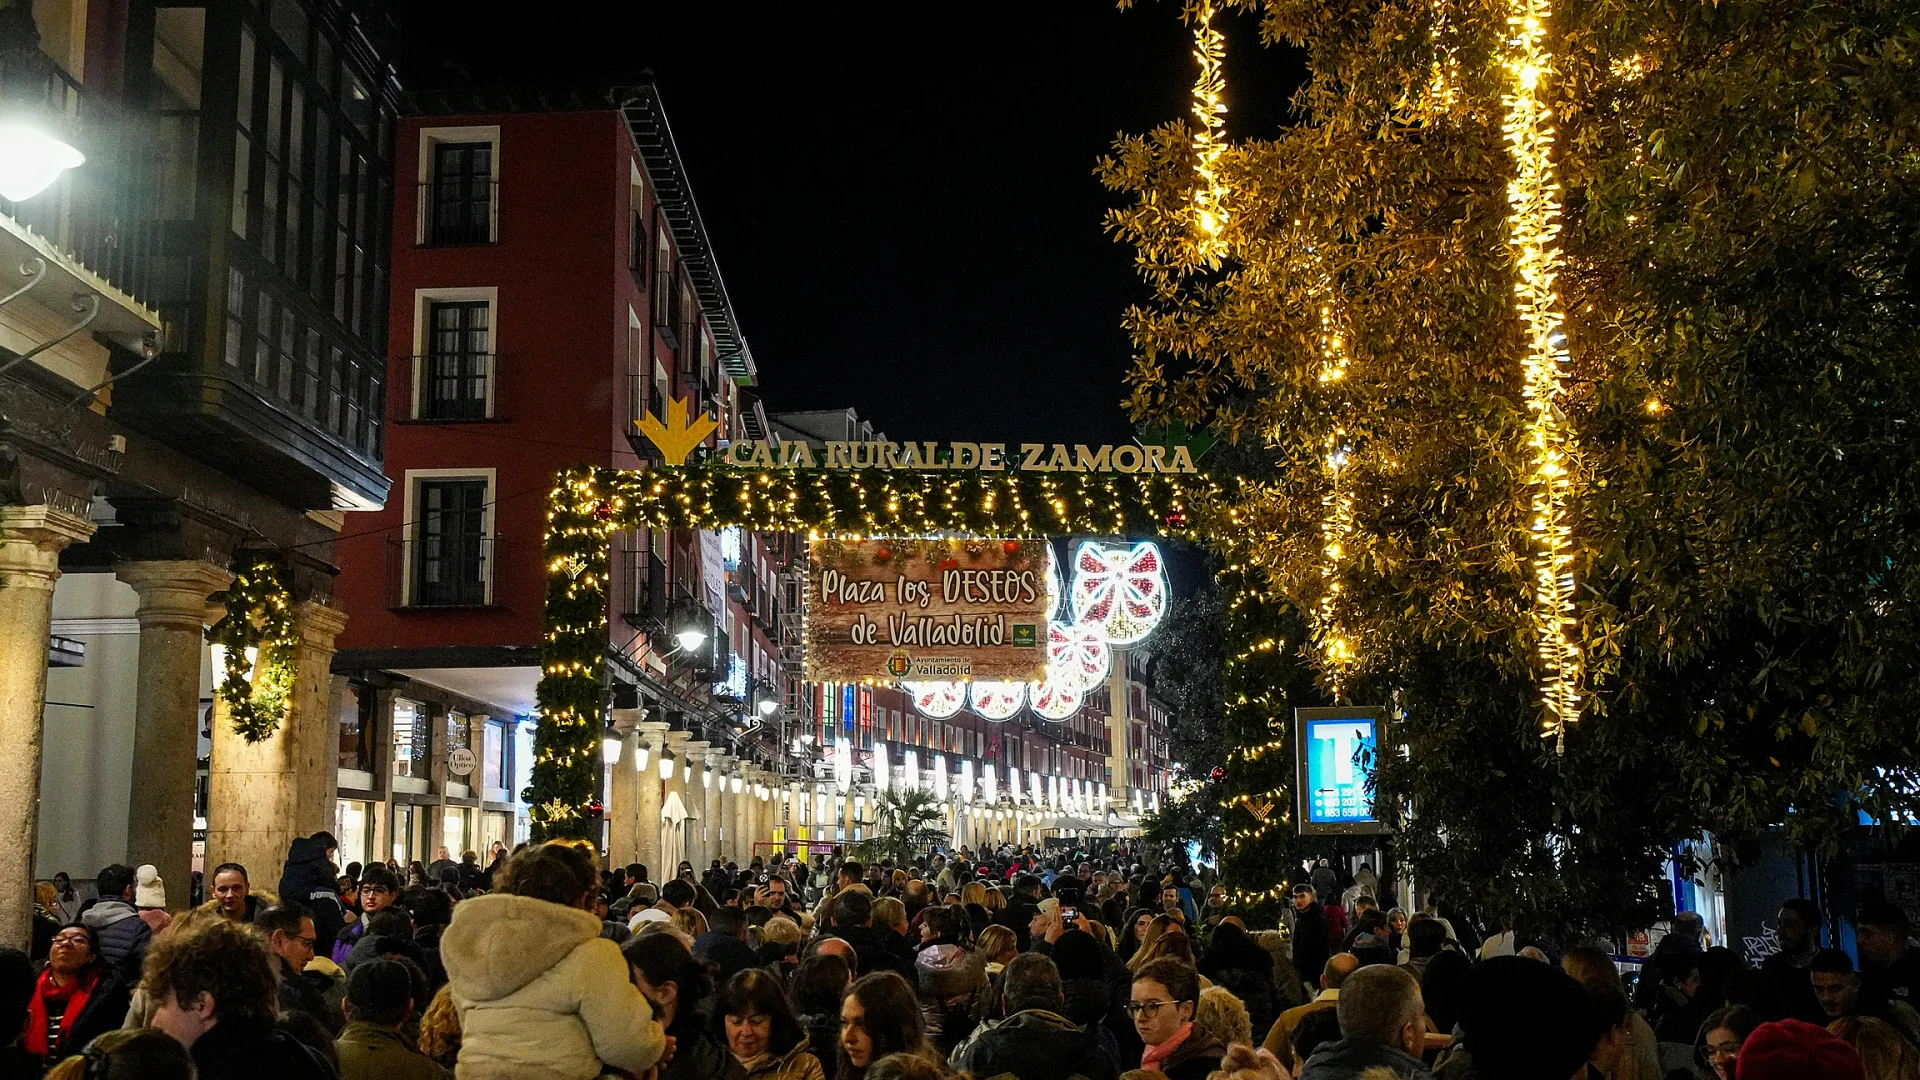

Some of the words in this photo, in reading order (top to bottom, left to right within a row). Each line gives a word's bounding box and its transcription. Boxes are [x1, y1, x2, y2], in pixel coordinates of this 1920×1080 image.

[727, 439, 817, 468] CAJA
[825, 441, 948, 469] RURAL
[950, 442, 1005, 471] DE
[1021, 443, 1198, 473] ZAMORA
[822, 569, 885, 604] Plaza
[897, 574, 931, 608] los
[943, 569, 1036, 603] DESEOS
[853, 613, 877, 645] de
[889, 611, 1005, 647] Valladolid
[917, 665, 971, 675] Valladolid
